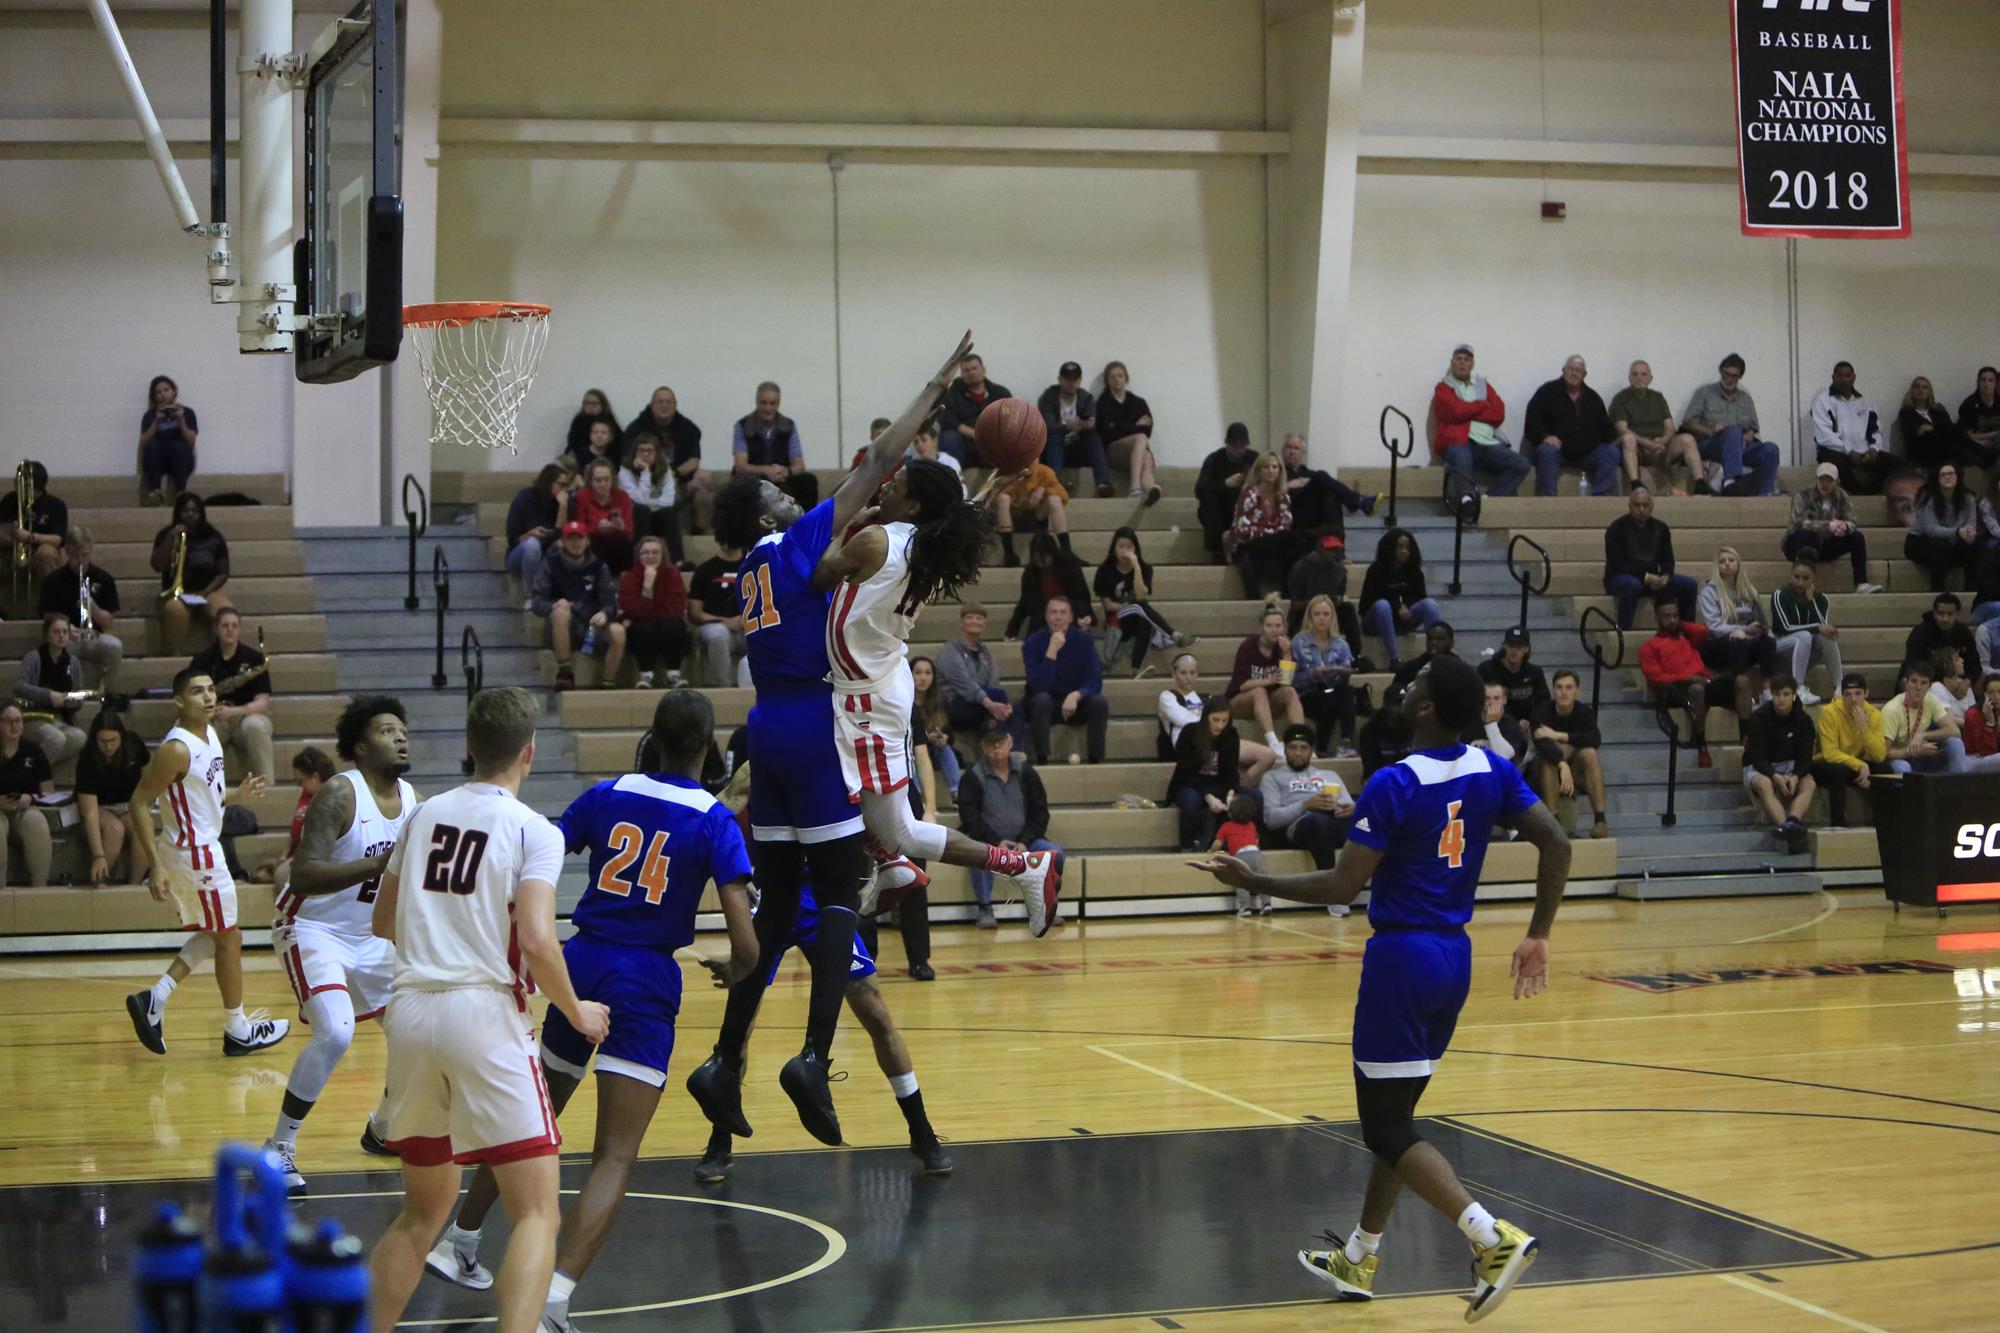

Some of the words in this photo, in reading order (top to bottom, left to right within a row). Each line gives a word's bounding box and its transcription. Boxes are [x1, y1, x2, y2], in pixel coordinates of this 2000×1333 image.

[1759, 31, 1872, 50] BASEBALL
[1773, 70, 1861, 100] NAIA
[1758, 99, 1876, 122] NATIONAL
[1747, 122, 1887, 145] CHAMPIONS
[1768, 169, 1869, 210] 2018
[741, 562, 782, 637] 21
[1438, 800, 1466, 869] 4
[422, 823, 489, 896] 20
[597, 821, 671, 906] 24
